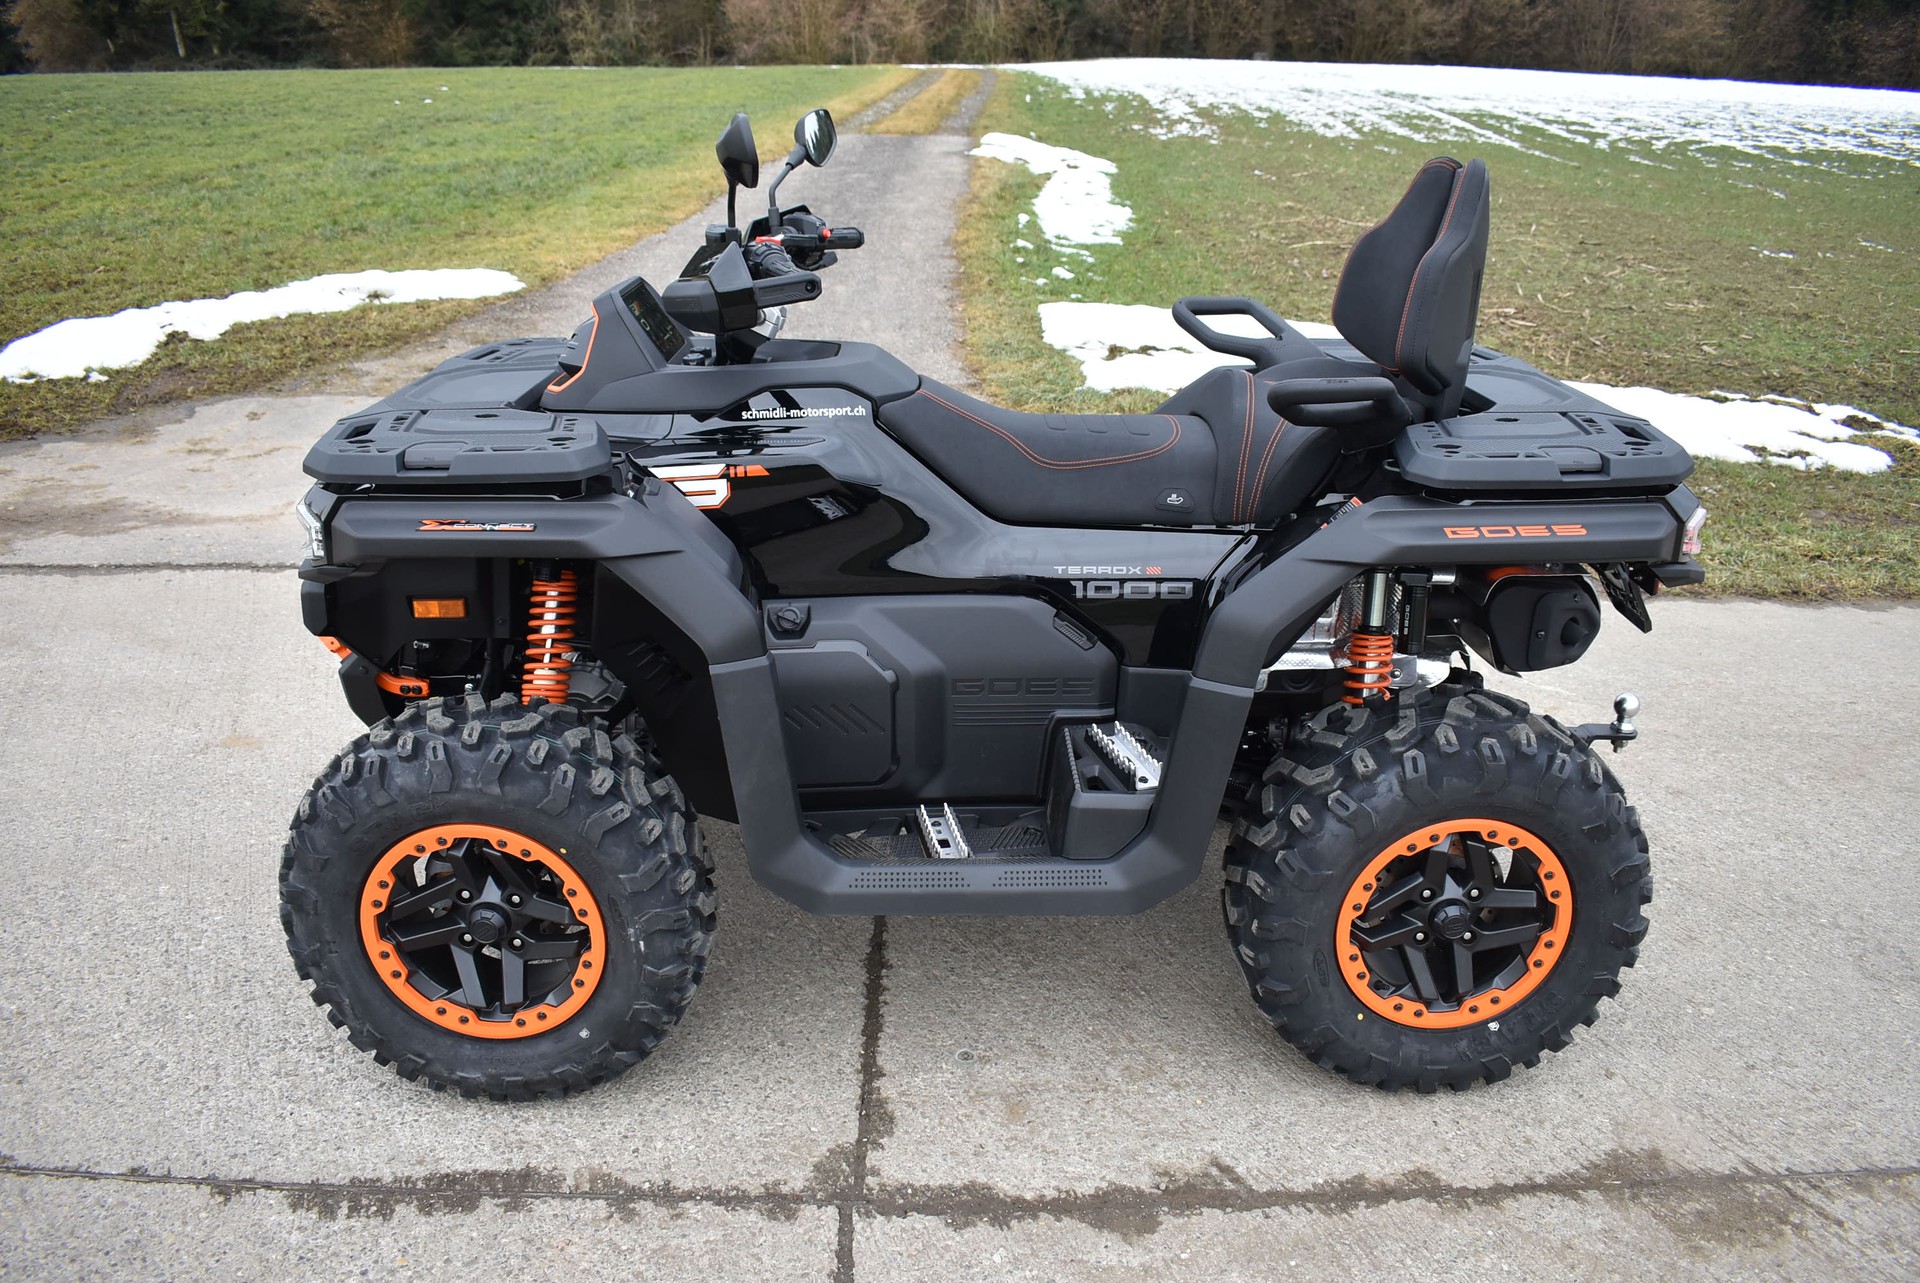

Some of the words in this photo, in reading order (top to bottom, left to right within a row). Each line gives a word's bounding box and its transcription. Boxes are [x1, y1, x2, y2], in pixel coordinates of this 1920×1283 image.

[741, 405, 866, 419] schmidli-motorsport.ch
[1442, 524, 1588, 539] GOES
[1053, 566, 1142, 575] TERROX
[1069, 580, 1194, 599] 1000
[951, 678, 1096, 697] GOES
